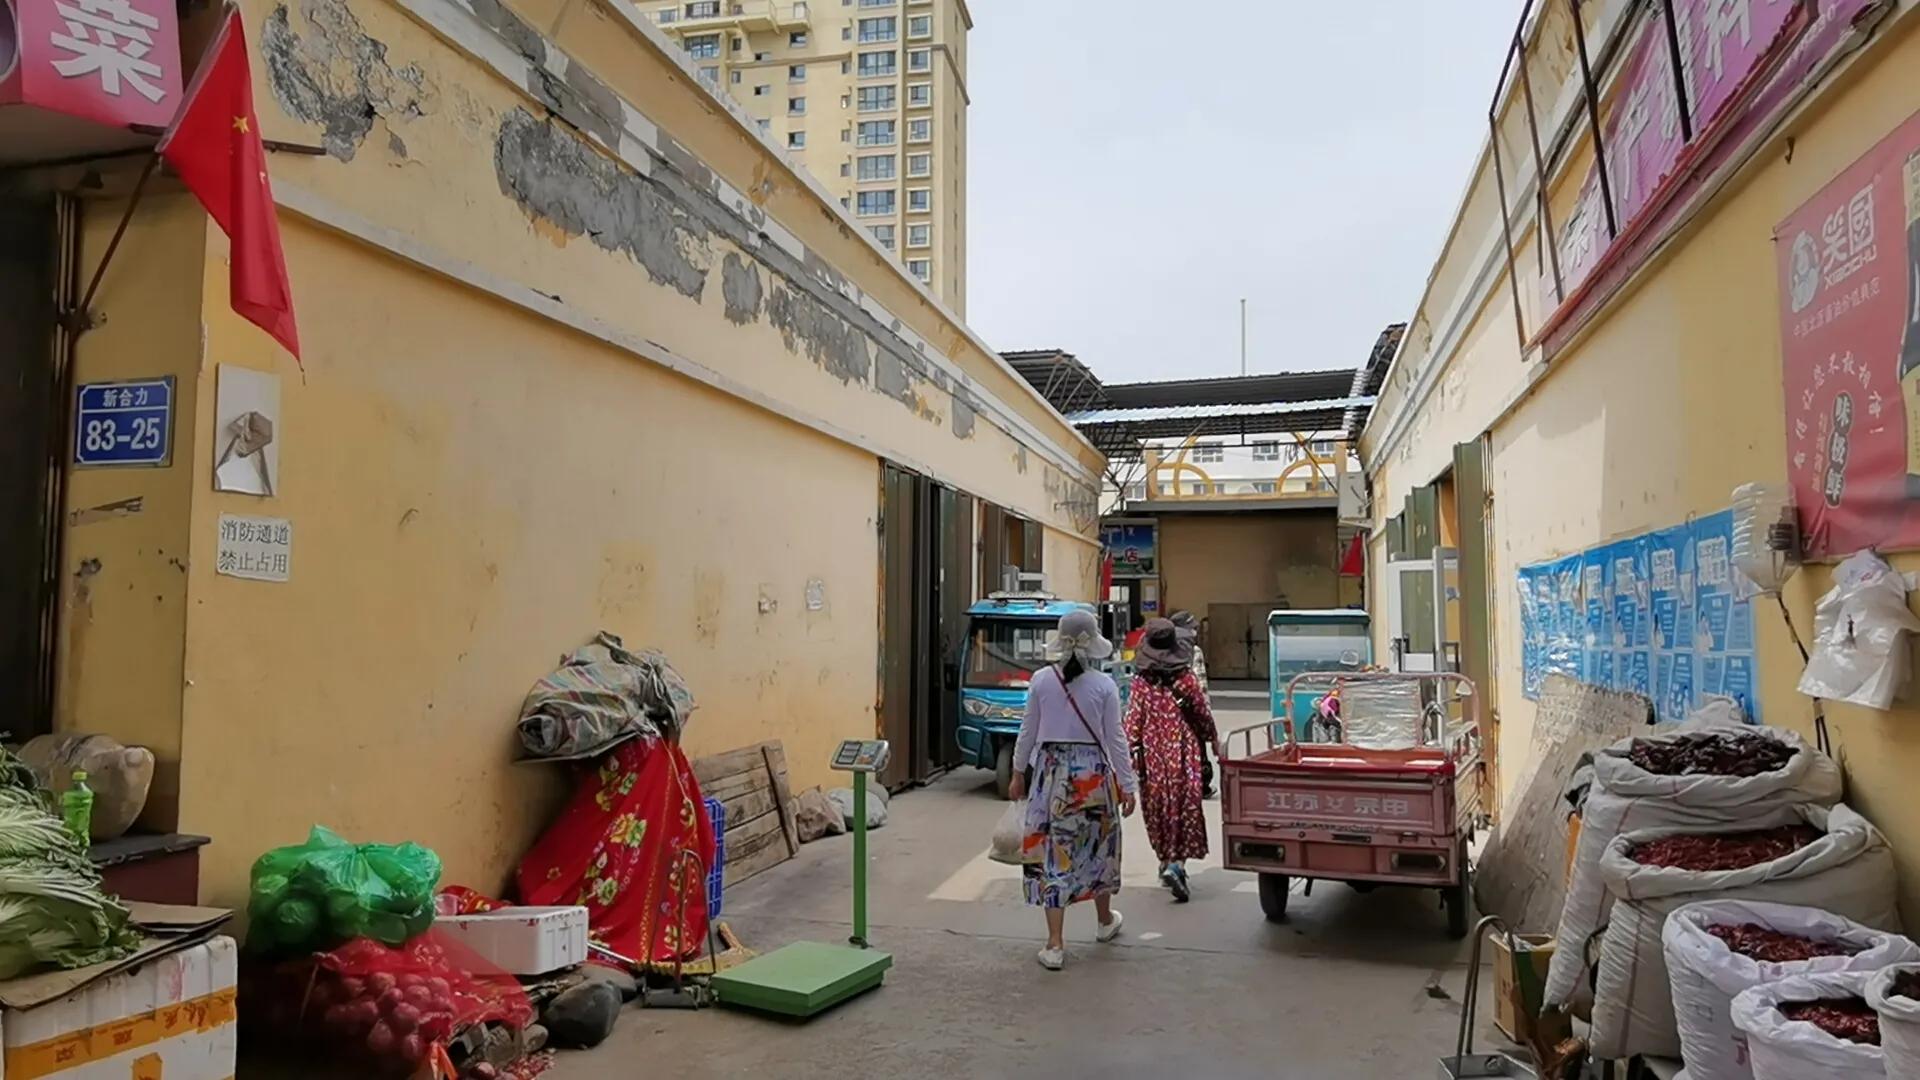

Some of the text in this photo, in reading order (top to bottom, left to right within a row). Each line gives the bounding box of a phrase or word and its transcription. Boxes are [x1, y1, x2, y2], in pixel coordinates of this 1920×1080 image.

[50, 0, 166, 103] 菜
[102, 387, 149, 408] 新合力
[86, 417, 160, 451] 83-25
[1825, 394, 1852, 501] 味极鲜
[222, 520, 289, 546] 消防通道
[219, 550, 287, 574] 禁止占用
